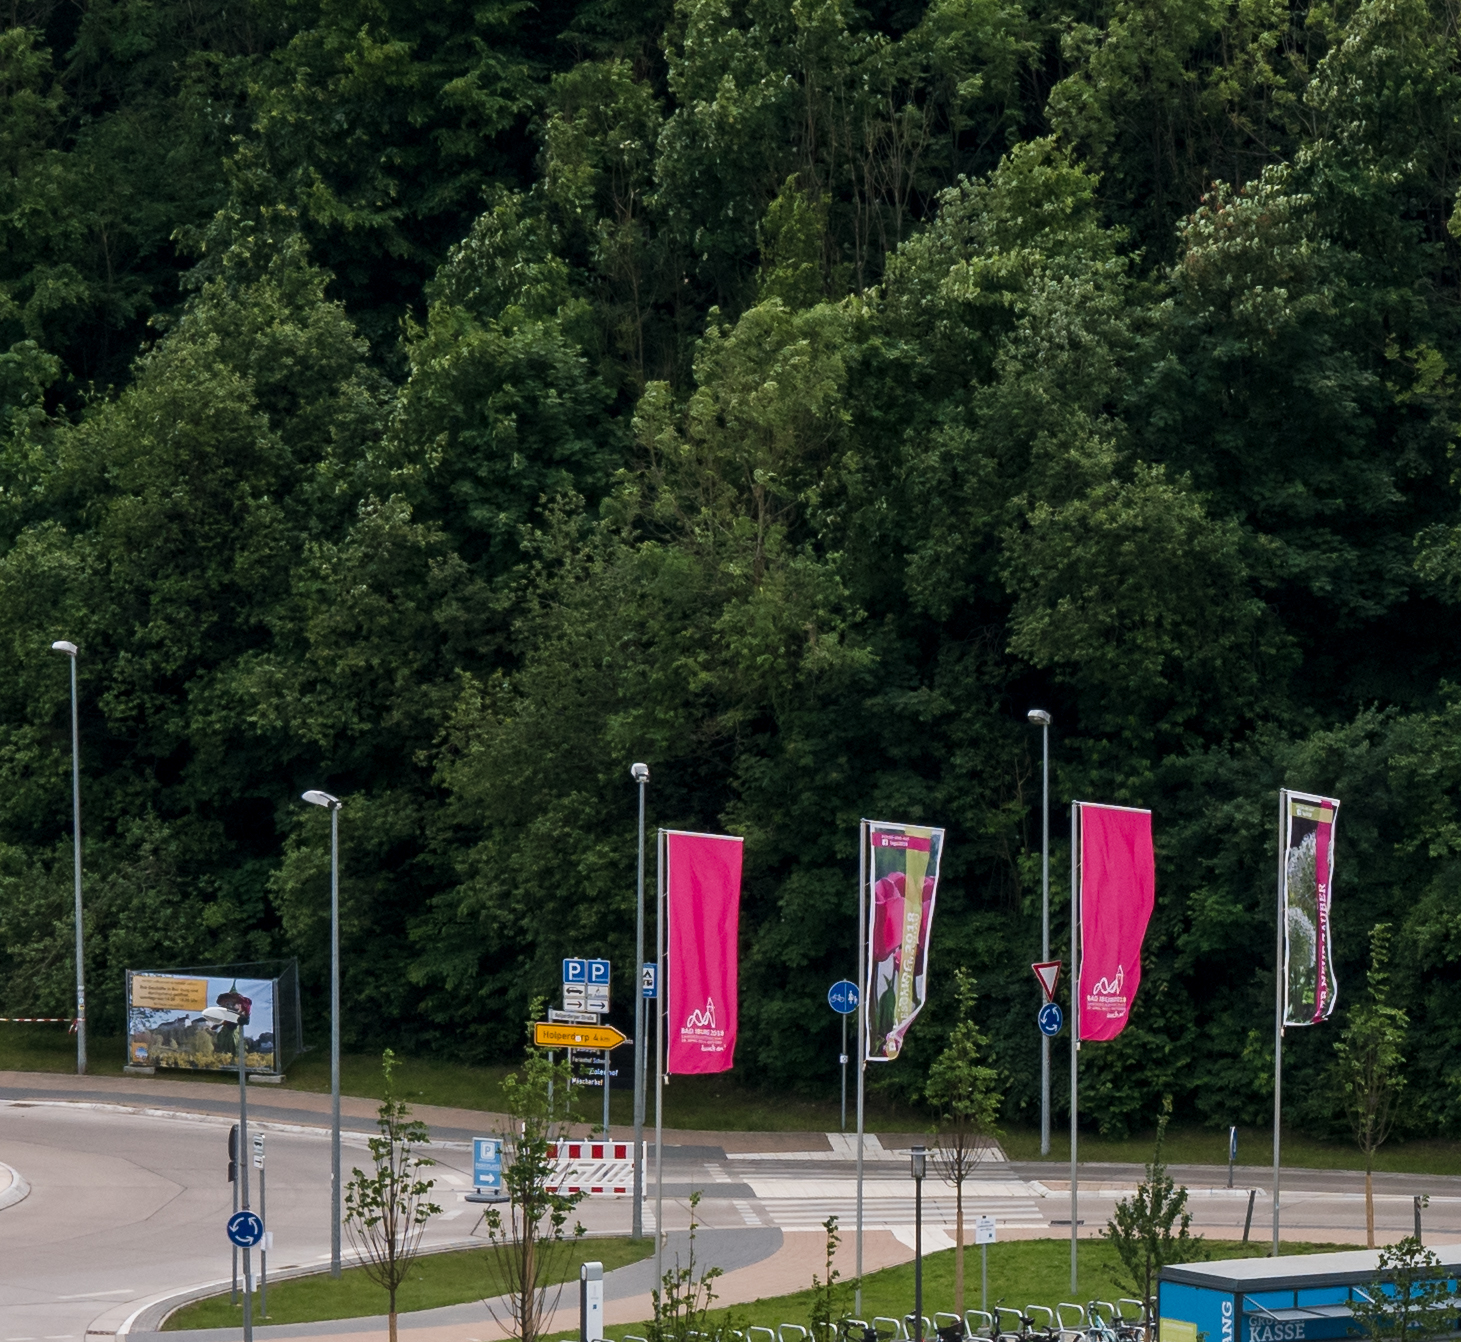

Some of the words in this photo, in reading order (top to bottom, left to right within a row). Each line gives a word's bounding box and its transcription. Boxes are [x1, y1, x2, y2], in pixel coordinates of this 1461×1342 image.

[568, 962, 581, 980] P
[592, 964, 604, 981] P
[1249, 1323, 1306, 1342] KASSE
